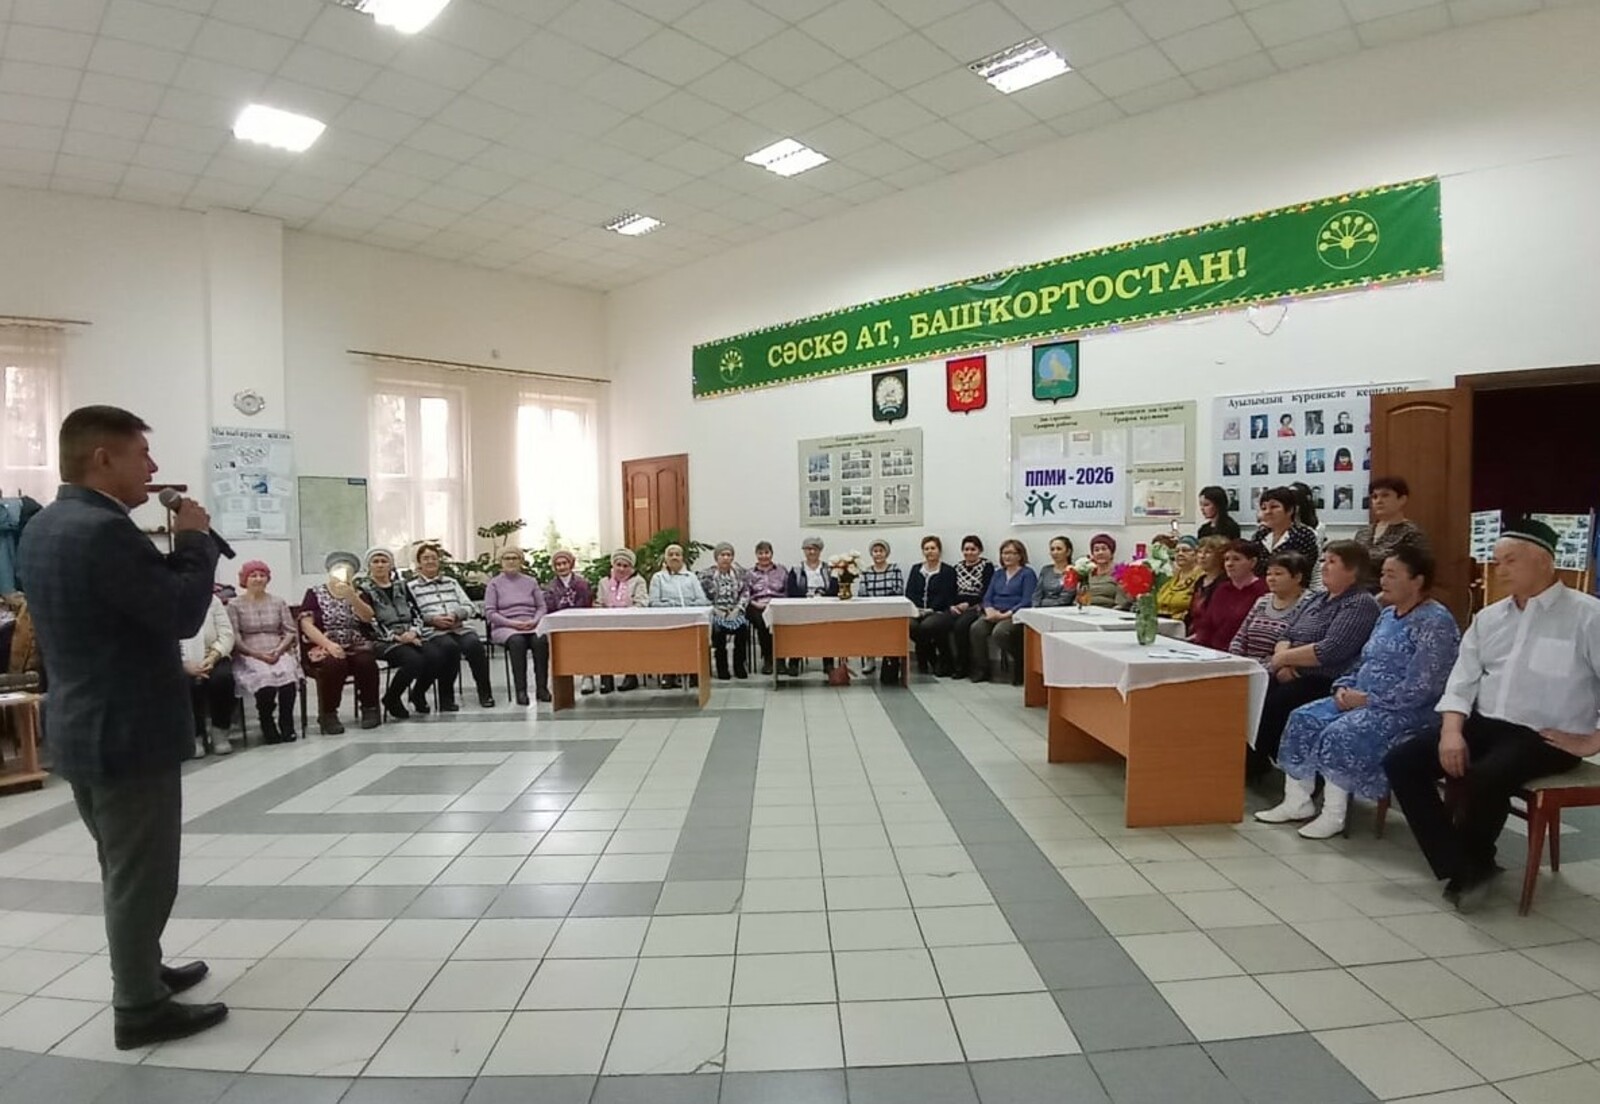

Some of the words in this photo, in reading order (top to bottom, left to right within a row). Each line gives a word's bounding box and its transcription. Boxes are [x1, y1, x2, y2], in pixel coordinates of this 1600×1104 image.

[767, 331, 848, 368] СӘСКӘ
[855, 319, 900, 349] АТ,
[909, 246, 1248, 340] БАШҠОРТОСТАН!
[1025, 469, 1066, 487] ППМИ
[1076, 466, 1114, 485] 2026
[1058, 501, 1068, 509] с.
[1070, 498, 1112, 509] Ташлы
